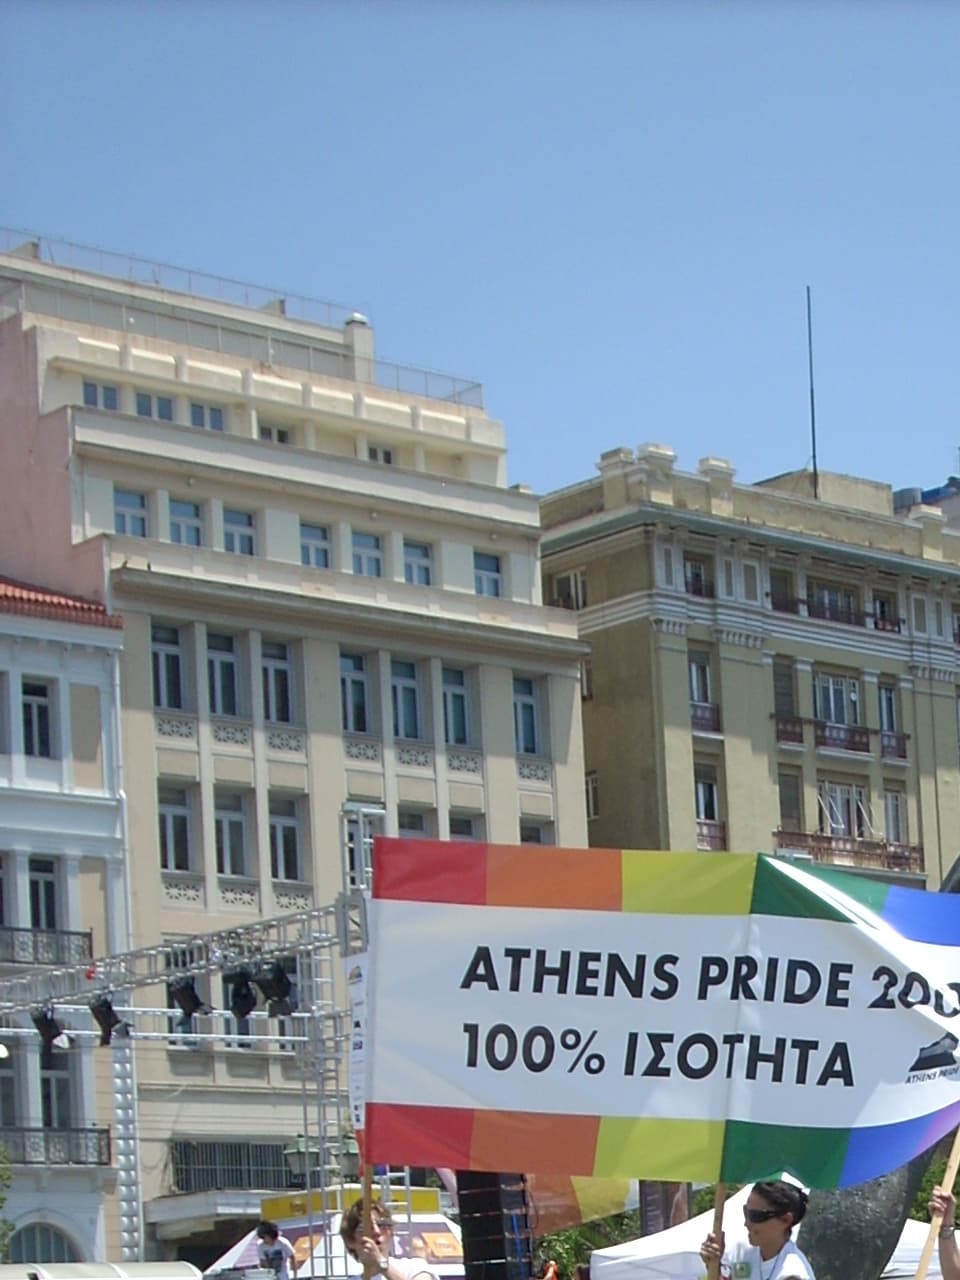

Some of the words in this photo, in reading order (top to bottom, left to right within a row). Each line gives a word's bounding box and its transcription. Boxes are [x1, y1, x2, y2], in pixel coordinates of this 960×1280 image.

[460, 945, 681, 1002] ATHENS
[697, 955, 855, 1008] PRIDE
[462, 1023, 605, 1075] 100%
[623, 1031, 854, 1087] ΙΣΟΤΗΤΑ
[904, 1071, 938, 1085] ATHENS
